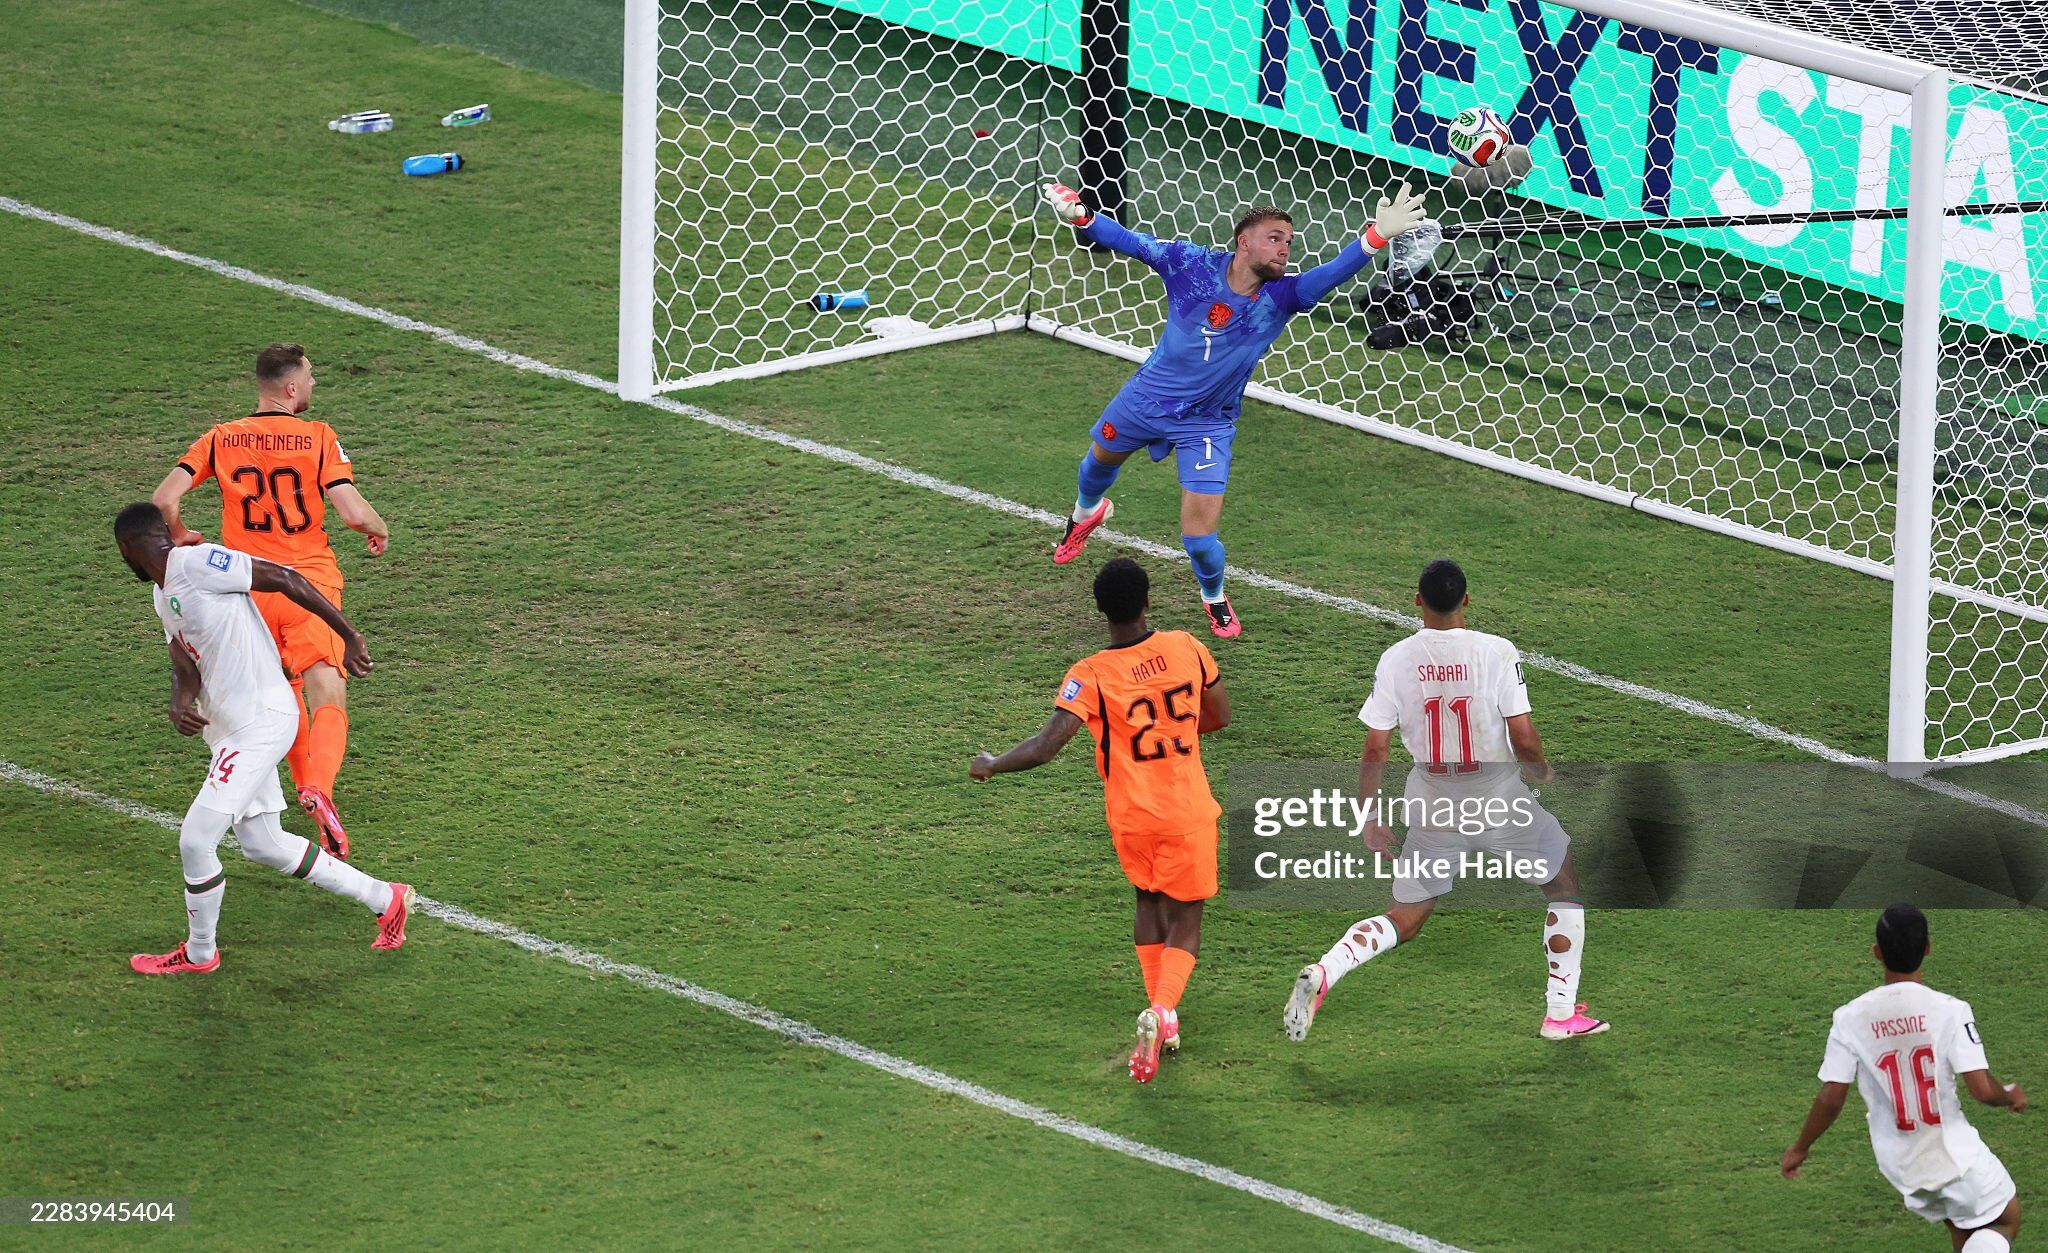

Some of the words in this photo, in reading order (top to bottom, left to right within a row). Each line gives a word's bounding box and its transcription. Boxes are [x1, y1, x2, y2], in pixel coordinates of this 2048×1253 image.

[1258, 0, 1719, 217] NEXT
[1203, 337, 1212, 362] 1
[222, 433, 313, 450] KOOPMEINERS
[1202, 437, 1212, 460] 1
[231, 465, 313, 535] 20
[1131, 655, 1168, 683] HATO
[1126, 680, 1197, 763] 25
[1424, 696, 1482, 776] 11
[209, 747, 240, 784] 14
[1871, 1014, 1927, 1040] YASSINE
[1875, 1044, 1943, 1132] 16
